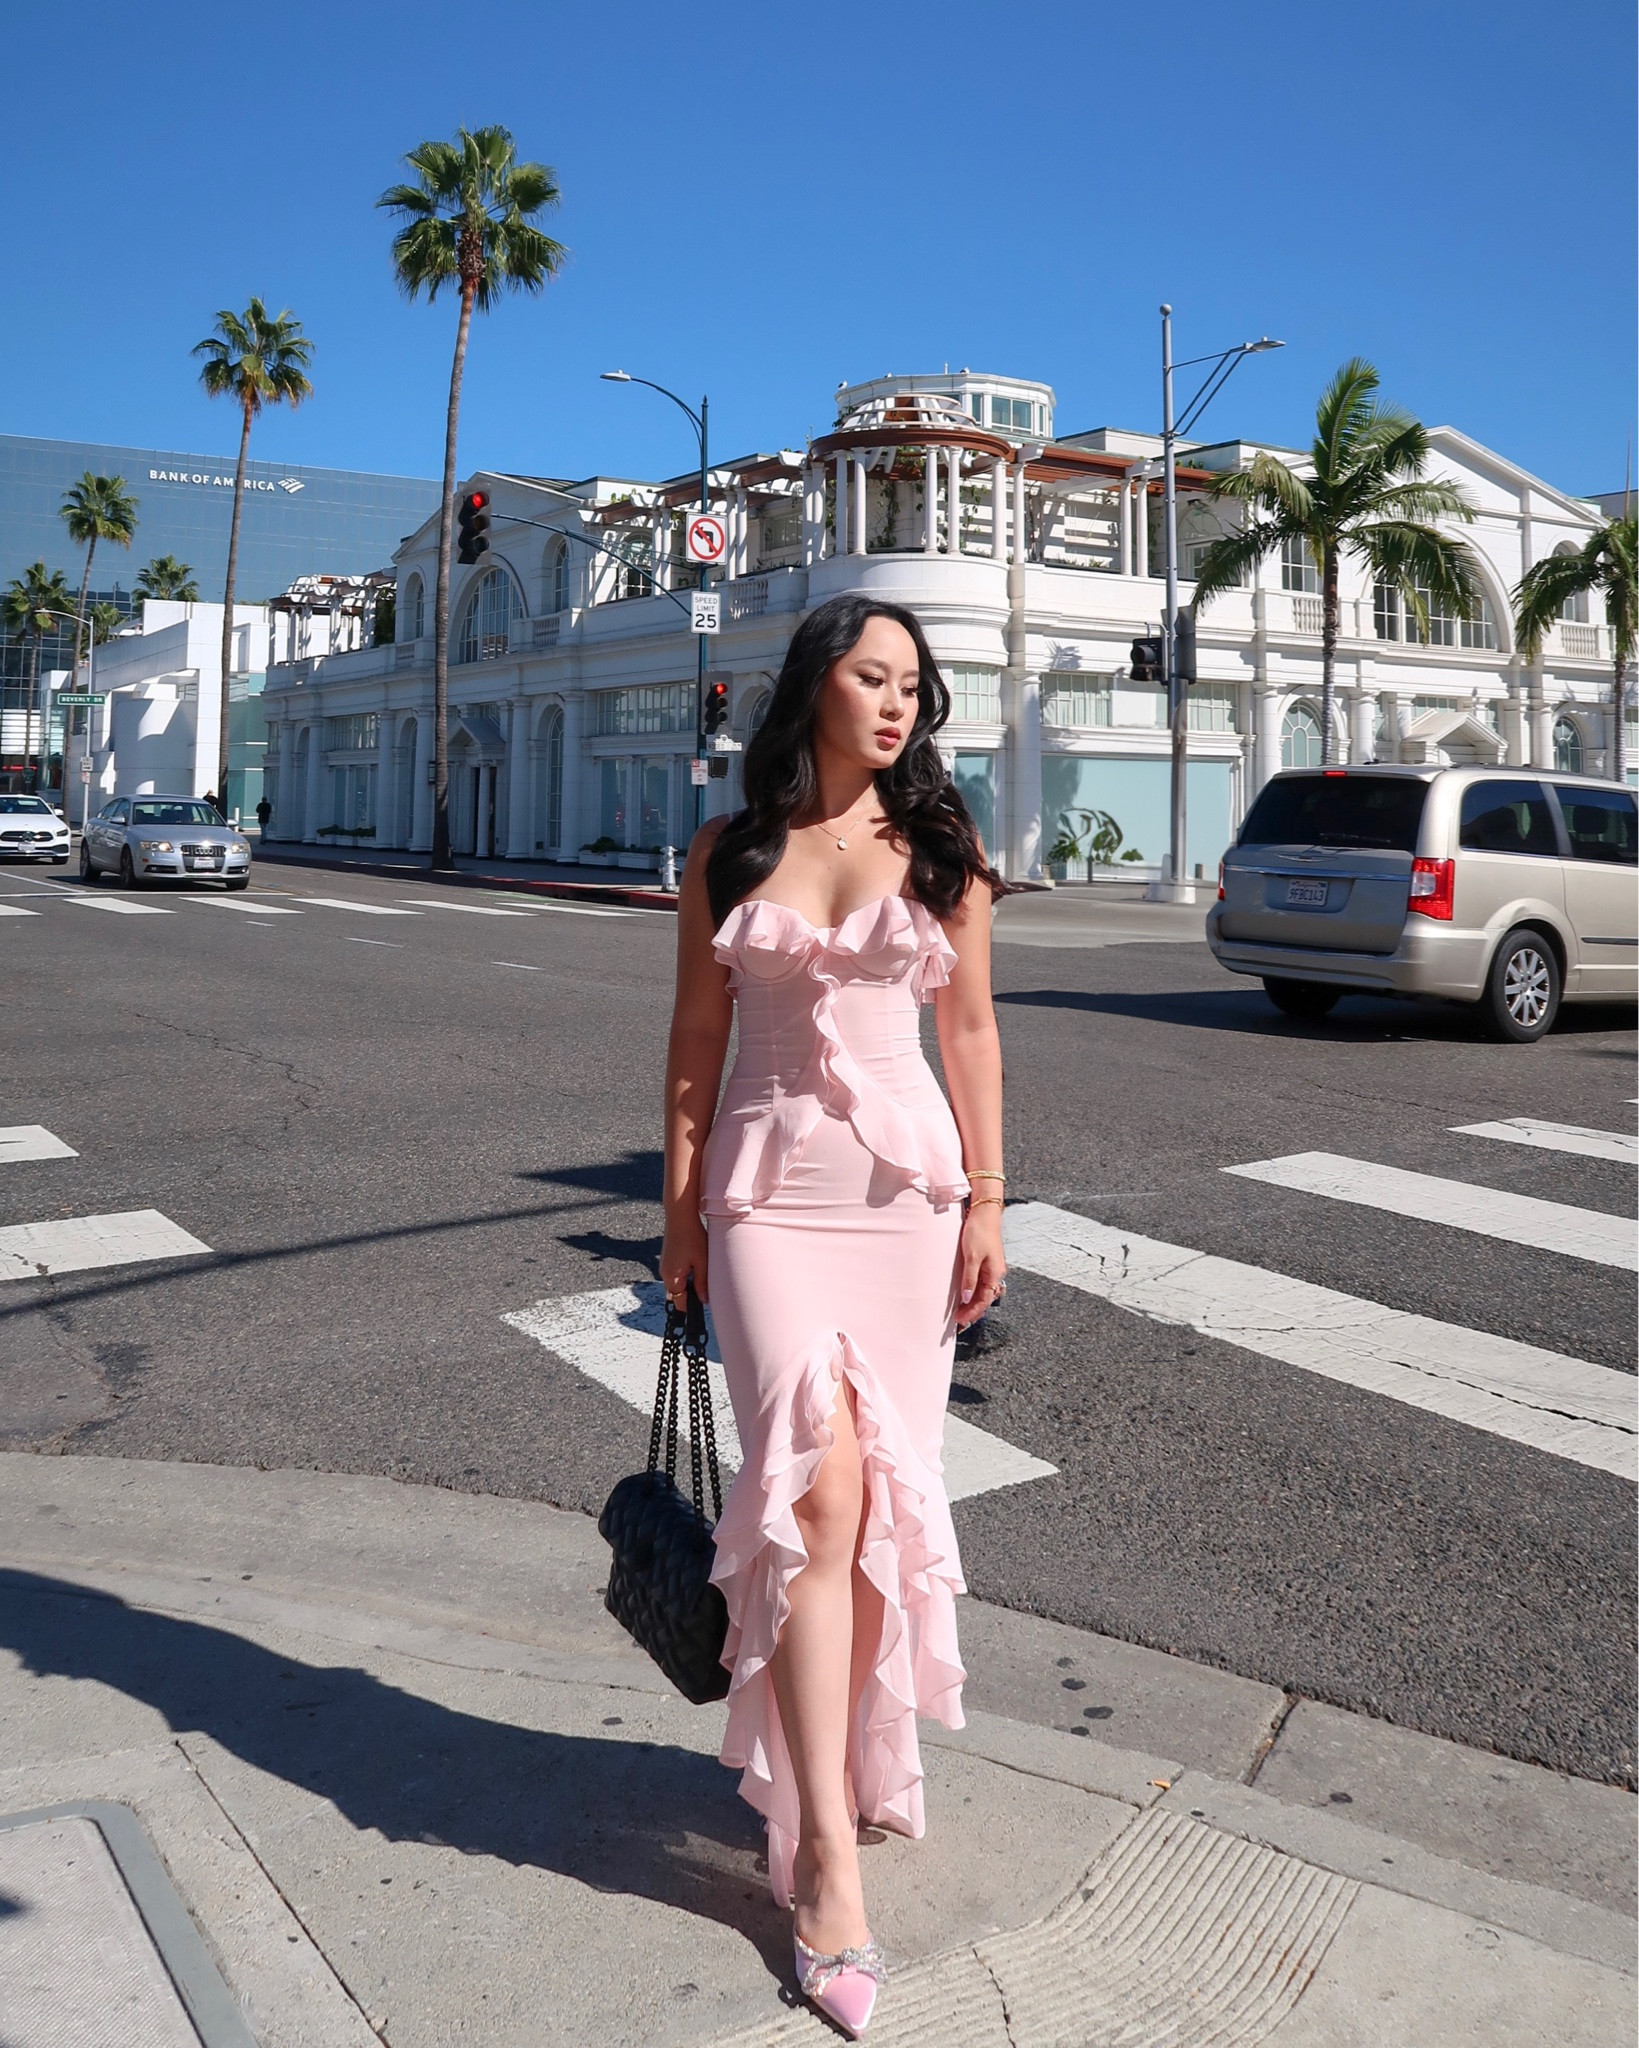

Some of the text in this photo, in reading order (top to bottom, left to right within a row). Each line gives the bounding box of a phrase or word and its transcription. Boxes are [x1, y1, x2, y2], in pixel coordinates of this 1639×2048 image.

[149, 469, 275, 491] BANK OF AMRICA
[695, 613, 717, 628] 25
